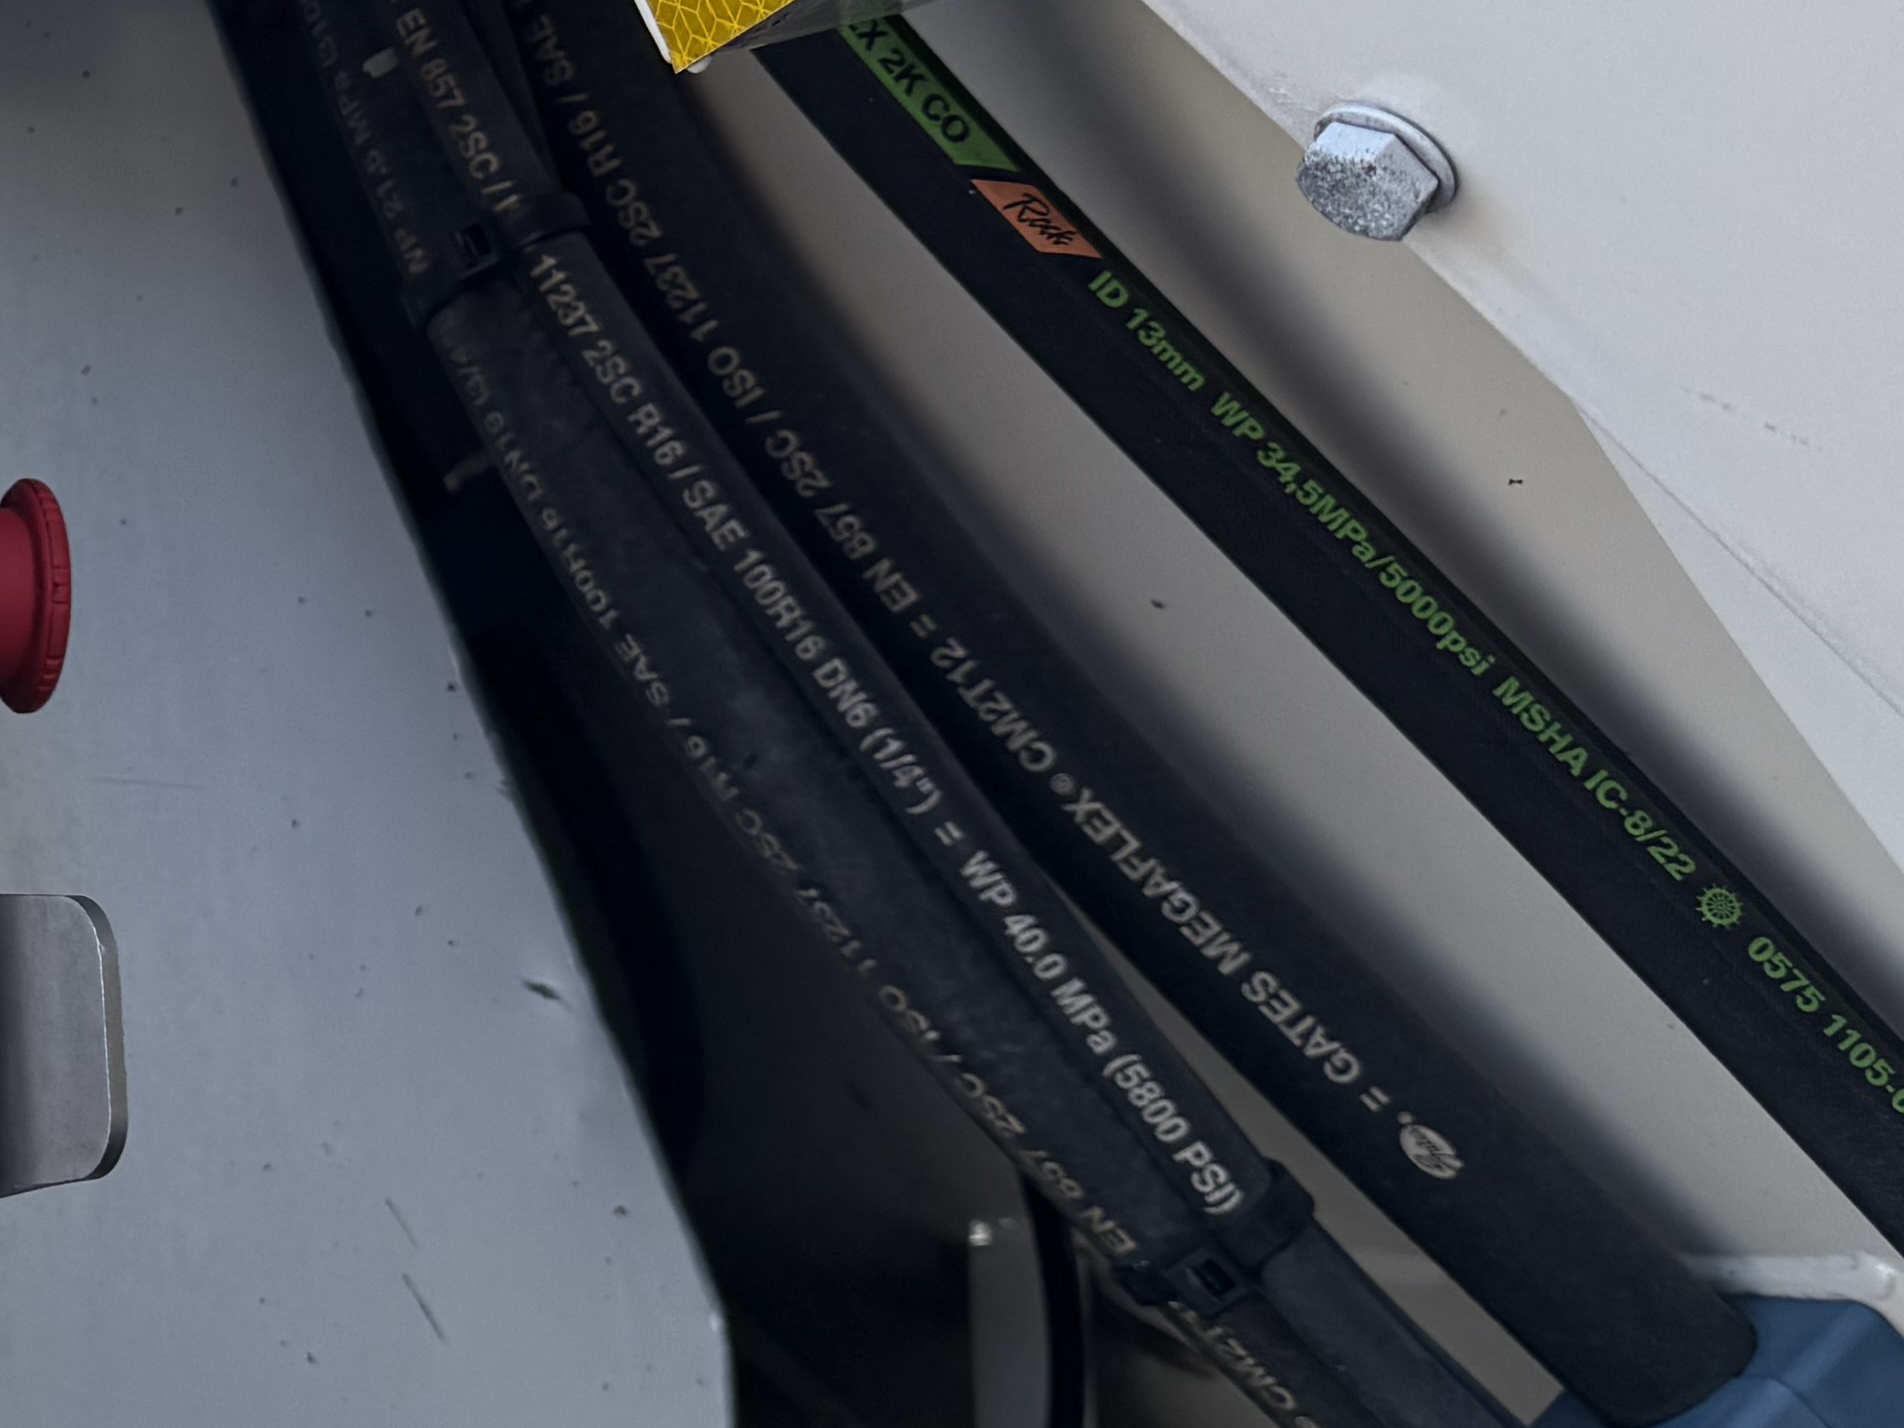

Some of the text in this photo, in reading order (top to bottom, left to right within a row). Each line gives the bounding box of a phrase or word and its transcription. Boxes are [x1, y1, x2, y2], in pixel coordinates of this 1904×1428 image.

[520, 8, 571, 87] SAE
[877, 52, 972, 145] 2K CO
[567, 110, 622, 177] R16
[604, 178, 662, 250] 2SC
[645, 253, 717, 344] 11237
[706, 346, 762, 410] ISO
[764, 428, 831, 500] 2SC
[814, 503, 880, 560] 857
[397, 9, 438, 58] EN
[419, 58, 465, 113] 857
[449, 114, 501, 180] 2SC
[530, 254, 599, 338] 11237
[583, 339, 641, 404] 2SC
[628, 404, 685, 467] R16
[683, 478, 748, 550] SAE
[733, 549, 826, 662] 100R16
[813, 655, 881, 730] DN6
[960, 849, 1018, 910] WP
[1003, 910, 1068, 982] 40.0
[1050, 974, 1120, 1058] MPa
[1101, 1052, 1190, 1147] (5800
[1174, 1138, 1246, 1216] PSI)
[866, 558, 918, 614] EN
[1088, 271, 1130, 310] ID
[1126, 307, 1206, 393] 13mm
[1209, 391, 1265, 444] WP
[1256, 442, 1495, 677] 34,5MPa/5000psi
[1493, 677, 1590, 778] MSHA
[1583, 770, 1696, 881] IC-8/22
[1748, 936, 1824, 1013] 0575
[930, 636, 1058, 773] CM2T12
[1241, 969, 1362, 1084] GATES
[1085, 1205, 1138, 1256] EN
